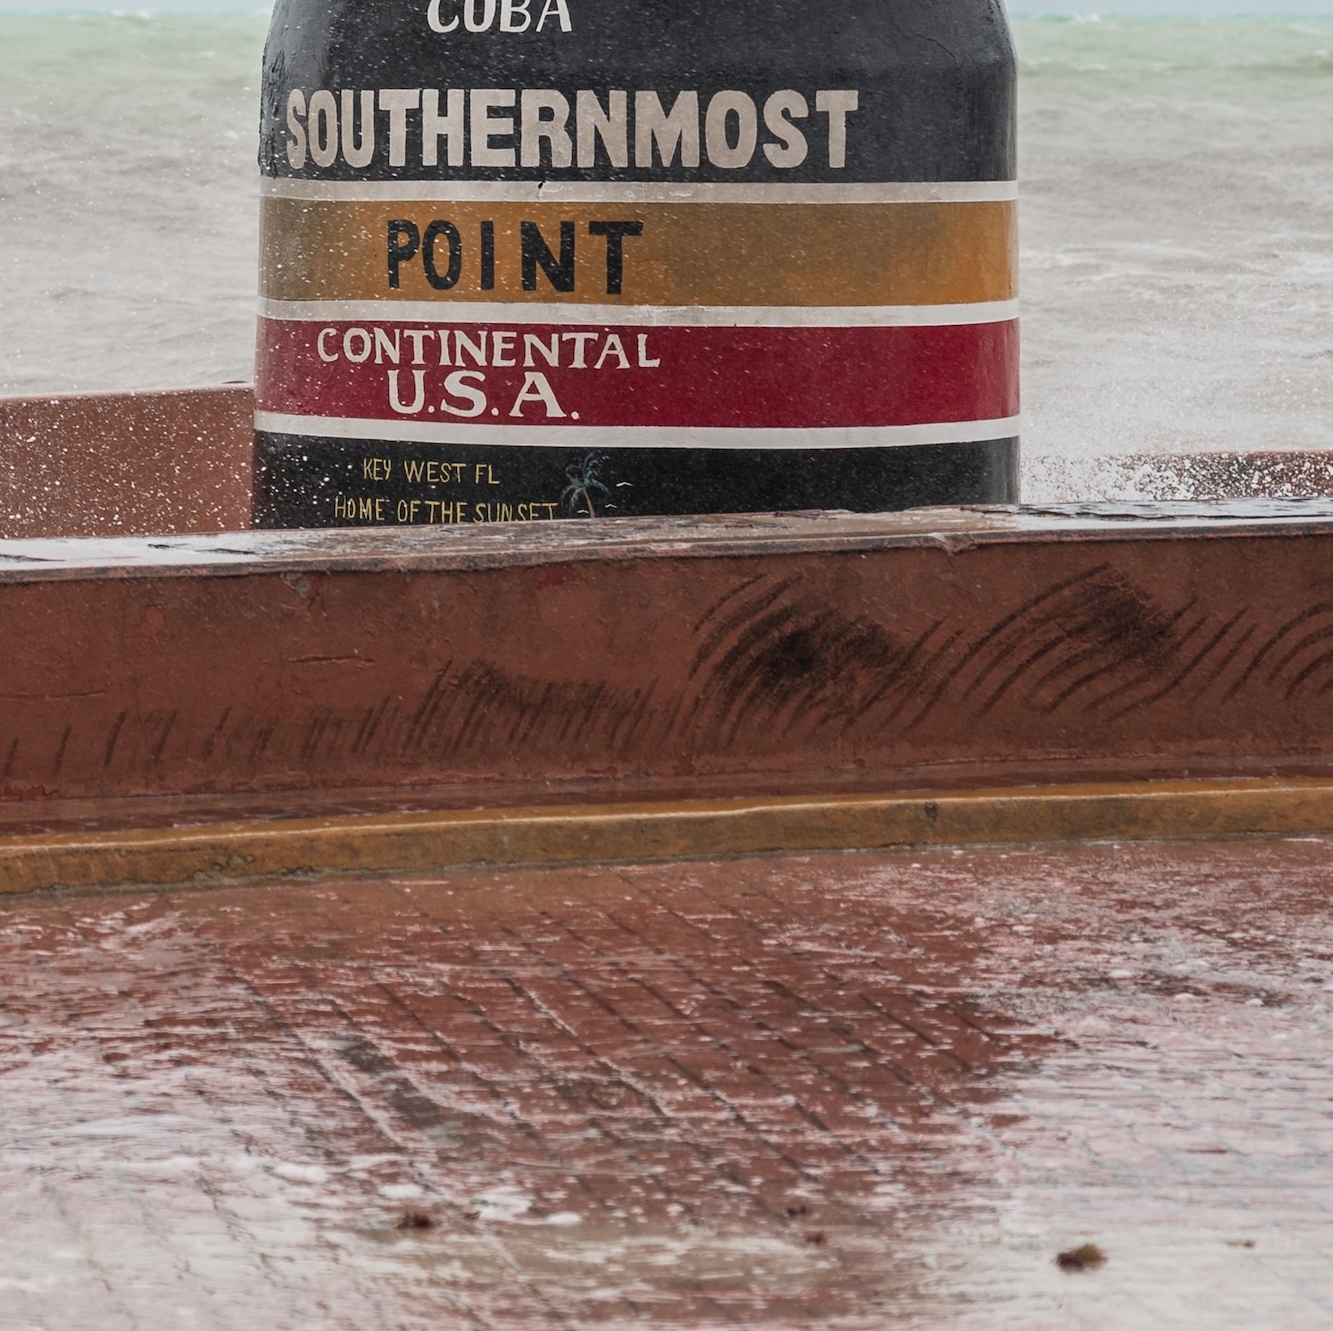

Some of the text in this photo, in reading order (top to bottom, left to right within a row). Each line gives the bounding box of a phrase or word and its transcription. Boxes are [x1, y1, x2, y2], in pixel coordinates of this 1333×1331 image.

[286, 88, 859, 170] SOUTHERNMOST
[387, 219, 643, 295] POINT
[317, 327, 661, 369] CONTINENTAL
[388, 369, 581, 420] U.S.A.
[363, 458, 501, 485] KEY WEST FL
[334, 495, 559, 524] HOME OF THE SUNSET
